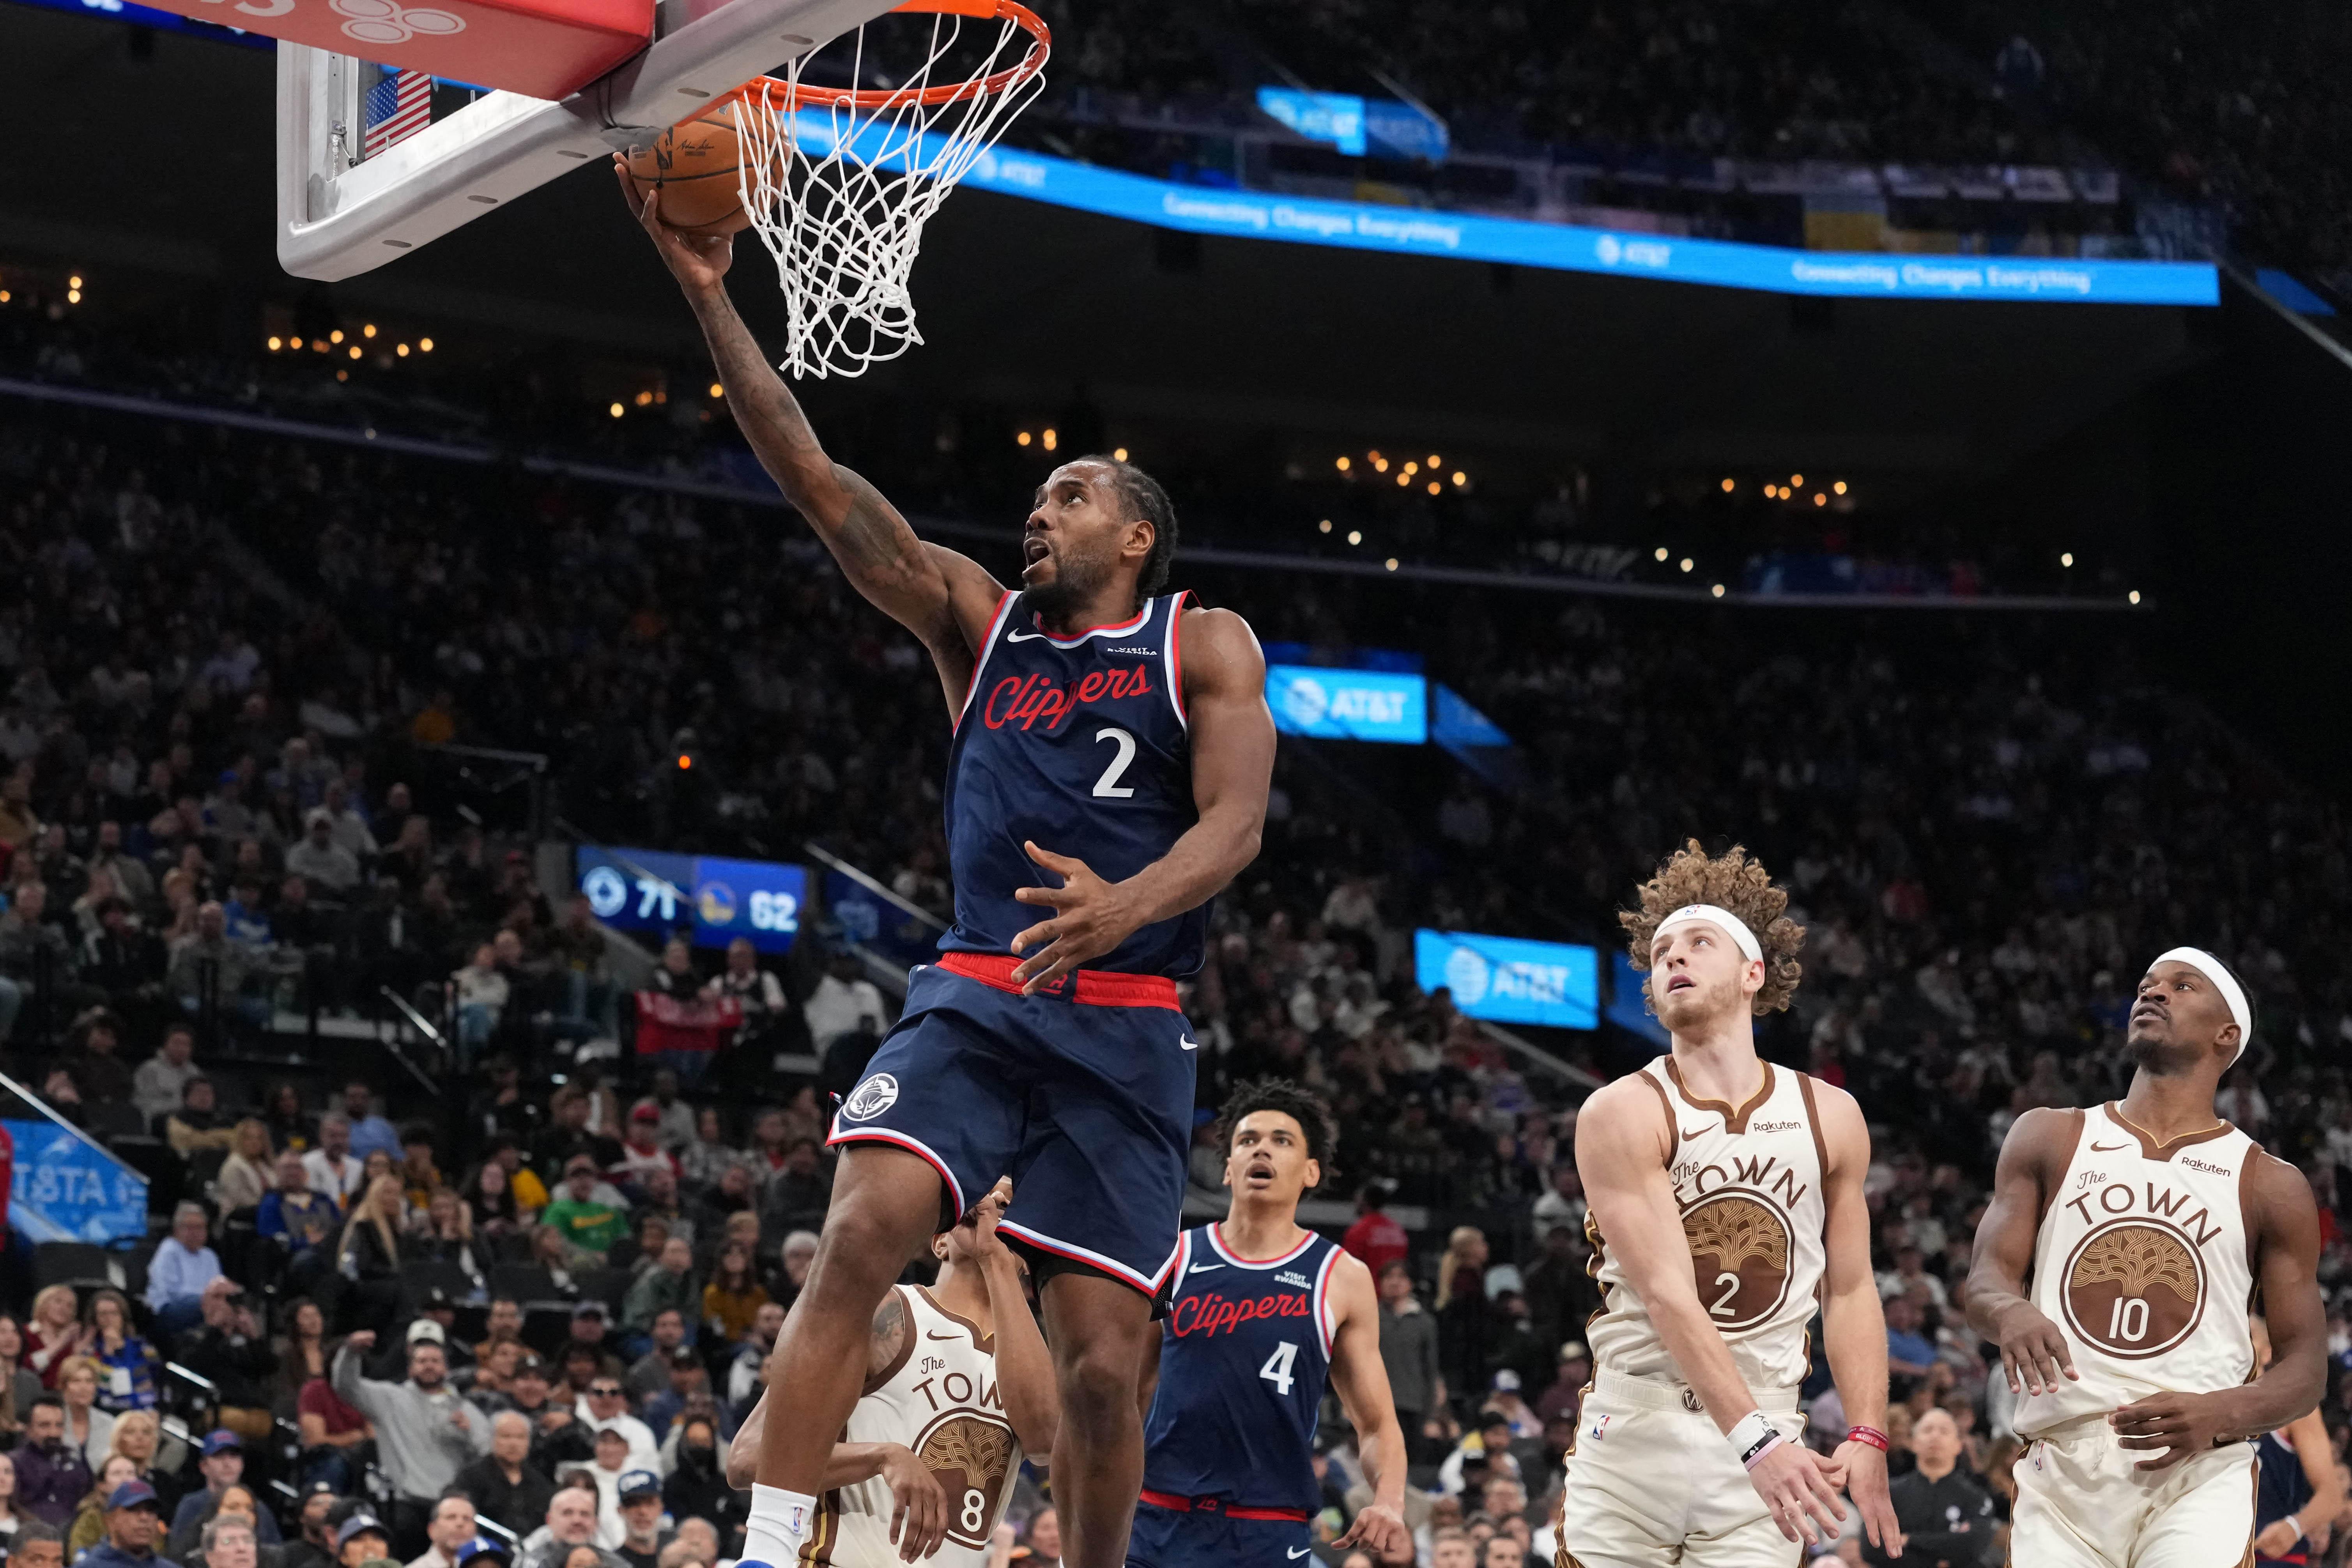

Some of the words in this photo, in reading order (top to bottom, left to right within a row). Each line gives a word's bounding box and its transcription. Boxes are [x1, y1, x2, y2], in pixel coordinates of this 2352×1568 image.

[984, 663, 1153, 731] Clippers
[1330, 689, 1407, 723] AT&T
[1092, 727, 1136, 798] 2
[637, 876, 677, 920] 71
[749, 890, 799, 932] 62
[1493, 962, 1570, 1002] AT&T
[1754, 1120, 1801, 1133] Rakuten
[1672, 1160, 1700, 1185] The
[1674, 1154, 1807, 1210] TOWN
[2077, 1170, 2107, 1189] The
[2182, 1157, 2231, 1177] Rakuten
[2065, 1182, 2222, 1247] TOWN
[1274, 1274, 1312, 1290] RWANDA
[1284, 1271, 1306, 1282] VISIT
[1710, 1272, 1740, 1317] 2
[1173, 1293, 1310, 1338] Clippers
[2108, 1296, 2150, 1342] 10
[921, 1356, 946, 1374] The
[1259, 1341, 1299, 1395] 4
[911, 1373, 1004, 1412] TOW
[1855, 1433, 1874, 1444] GLORY
[961, 1489, 985, 1532] 8
